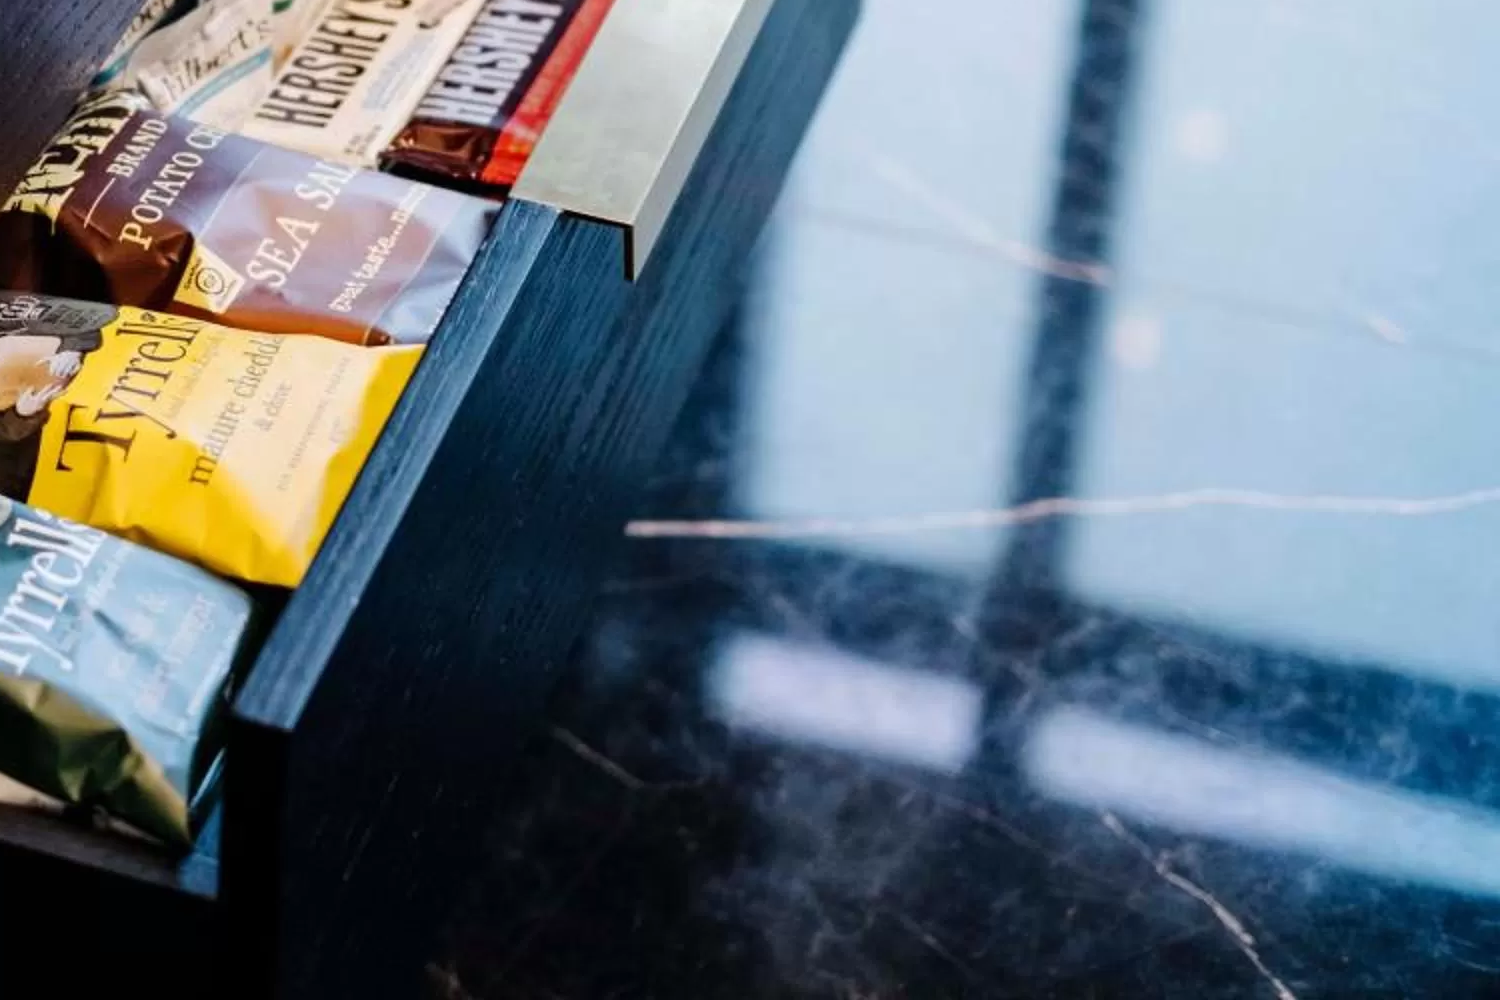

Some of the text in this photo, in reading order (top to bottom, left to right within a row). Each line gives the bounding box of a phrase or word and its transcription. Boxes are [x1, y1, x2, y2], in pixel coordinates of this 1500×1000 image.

[106, 118, 169, 178] BRAND
[119, 151, 204, 251] POTATO
[245, 216, 322, 289] SEA
[188, 400, 246, 487] mature
